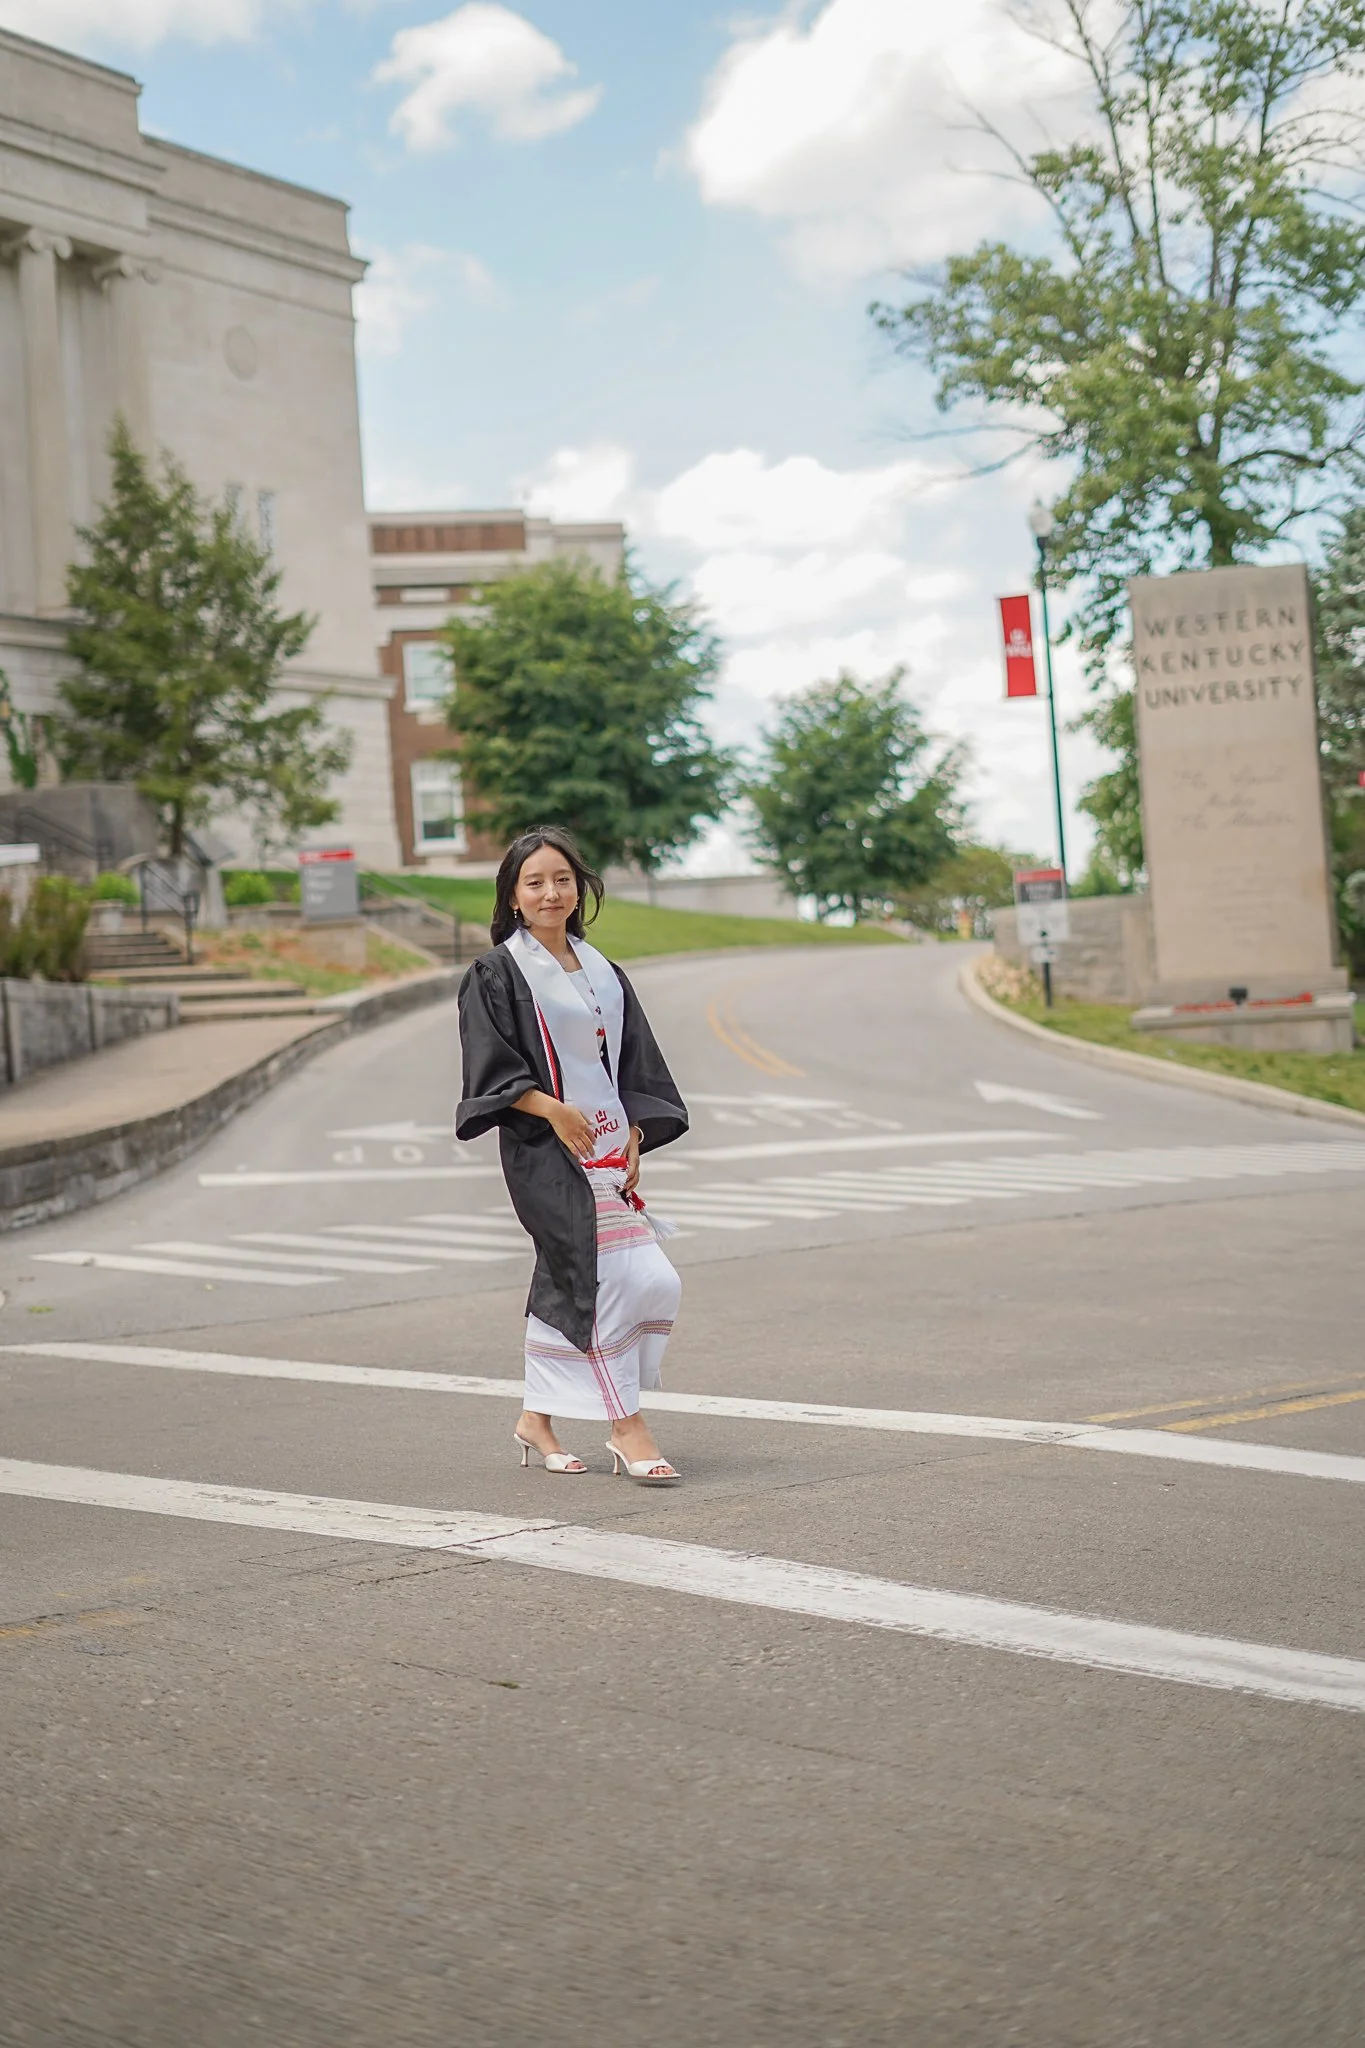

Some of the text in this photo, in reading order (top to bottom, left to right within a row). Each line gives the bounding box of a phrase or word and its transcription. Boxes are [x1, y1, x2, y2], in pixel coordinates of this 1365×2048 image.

[1143, 606, 1296, 638] WESTERN
[1140, 640, 1304, 674] KENTUCKY
[1145, 675, 1303, 710] UNIVERSITY
[592, 1119, 619, 1138] WKU
[332, 1144, 484, 1165] TOP
